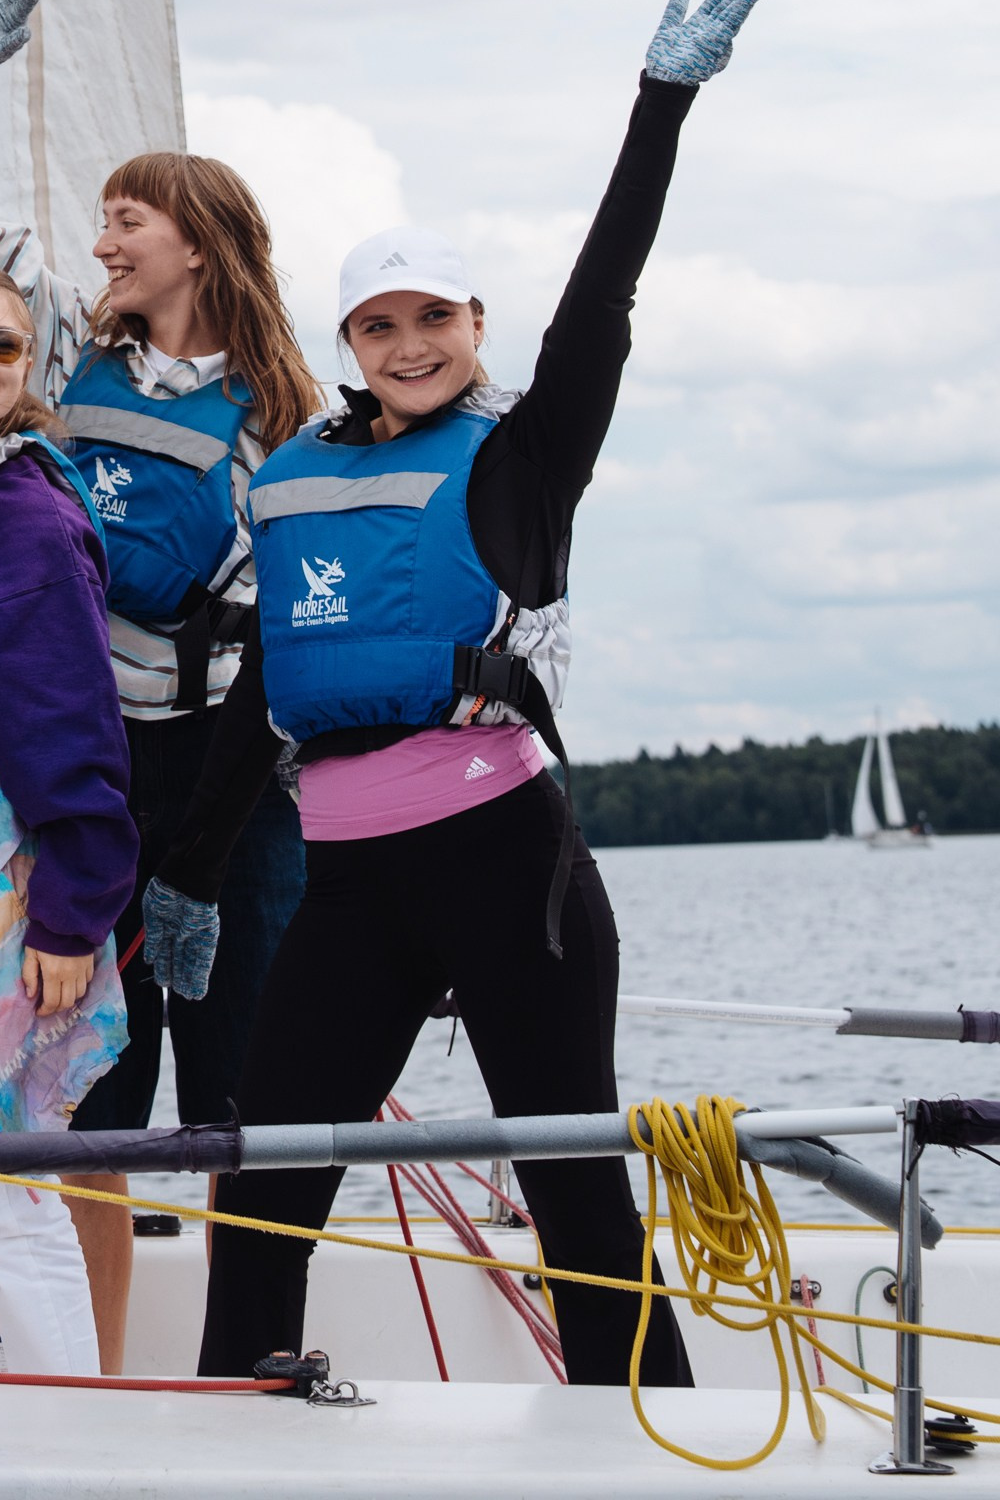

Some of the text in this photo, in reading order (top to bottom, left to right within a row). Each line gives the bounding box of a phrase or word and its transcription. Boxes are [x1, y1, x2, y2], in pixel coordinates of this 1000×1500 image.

[90, 492, 128, 517] RESAIL
[292, 596, 349, 619] MORESAIL
[464, 764, 495, 780] adidas
